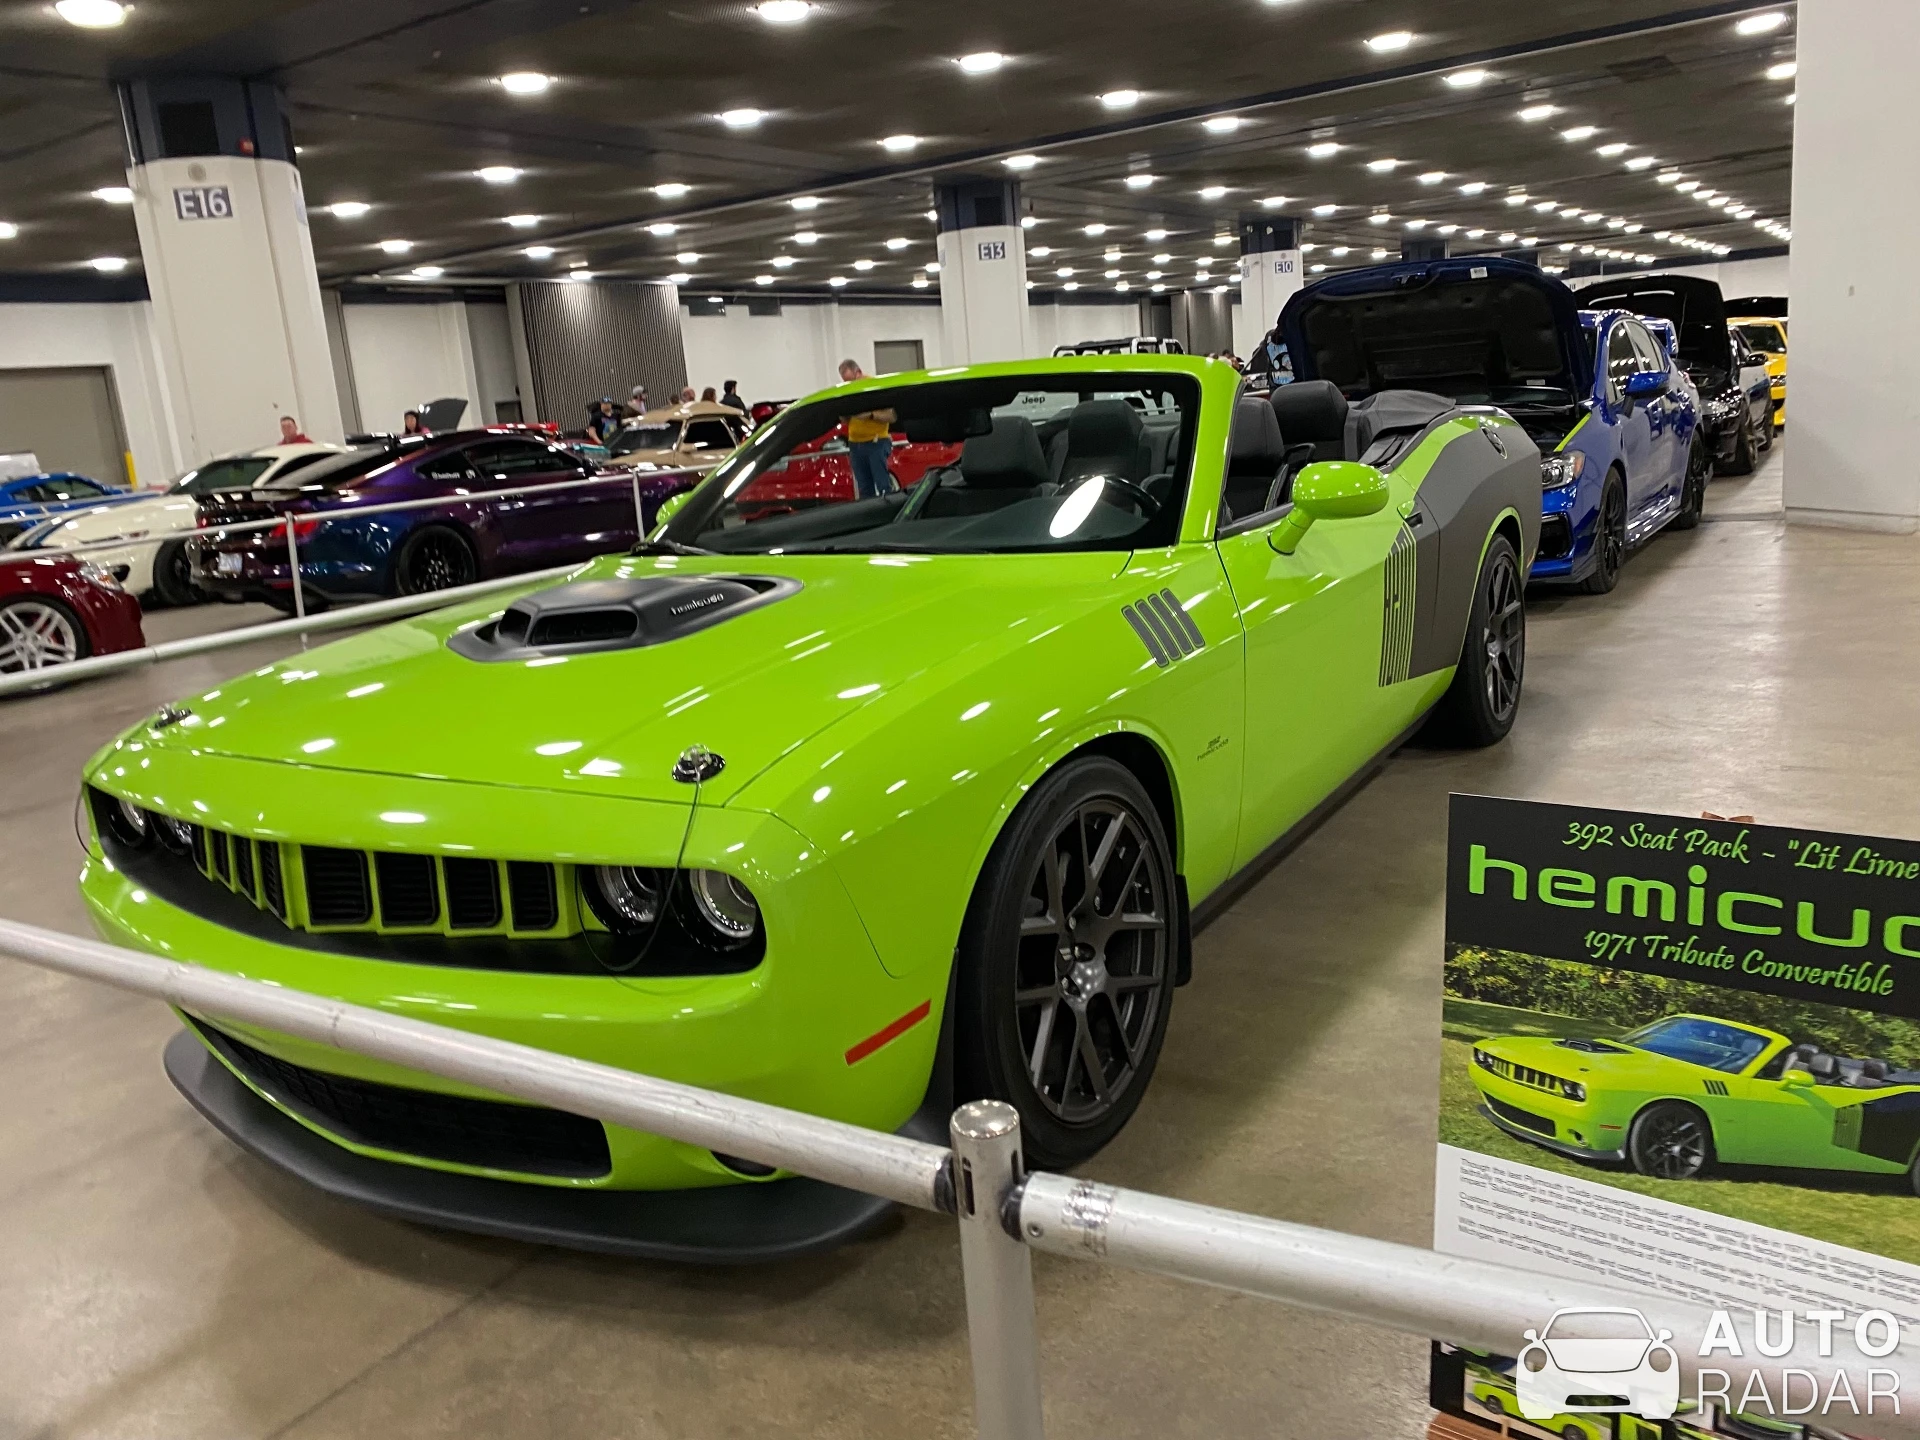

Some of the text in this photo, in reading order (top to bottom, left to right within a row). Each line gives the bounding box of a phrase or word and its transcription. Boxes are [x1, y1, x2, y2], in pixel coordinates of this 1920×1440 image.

[177, 188, 228, 218] E16
[980, 242, 1004, 260] E13
[1276, 261, 1293, 273] E10
[1021, 396, 1046, 405] Jeep
[1562, 822, 1614, 848] 392
[1620, 823, 1678, 852] Scat
[1684, 829, 1751, 864] Pack
[1788, 840, 1841, 870] "Lit
[1583, 930, 1894, 996] 1971 Tribute Convertible
